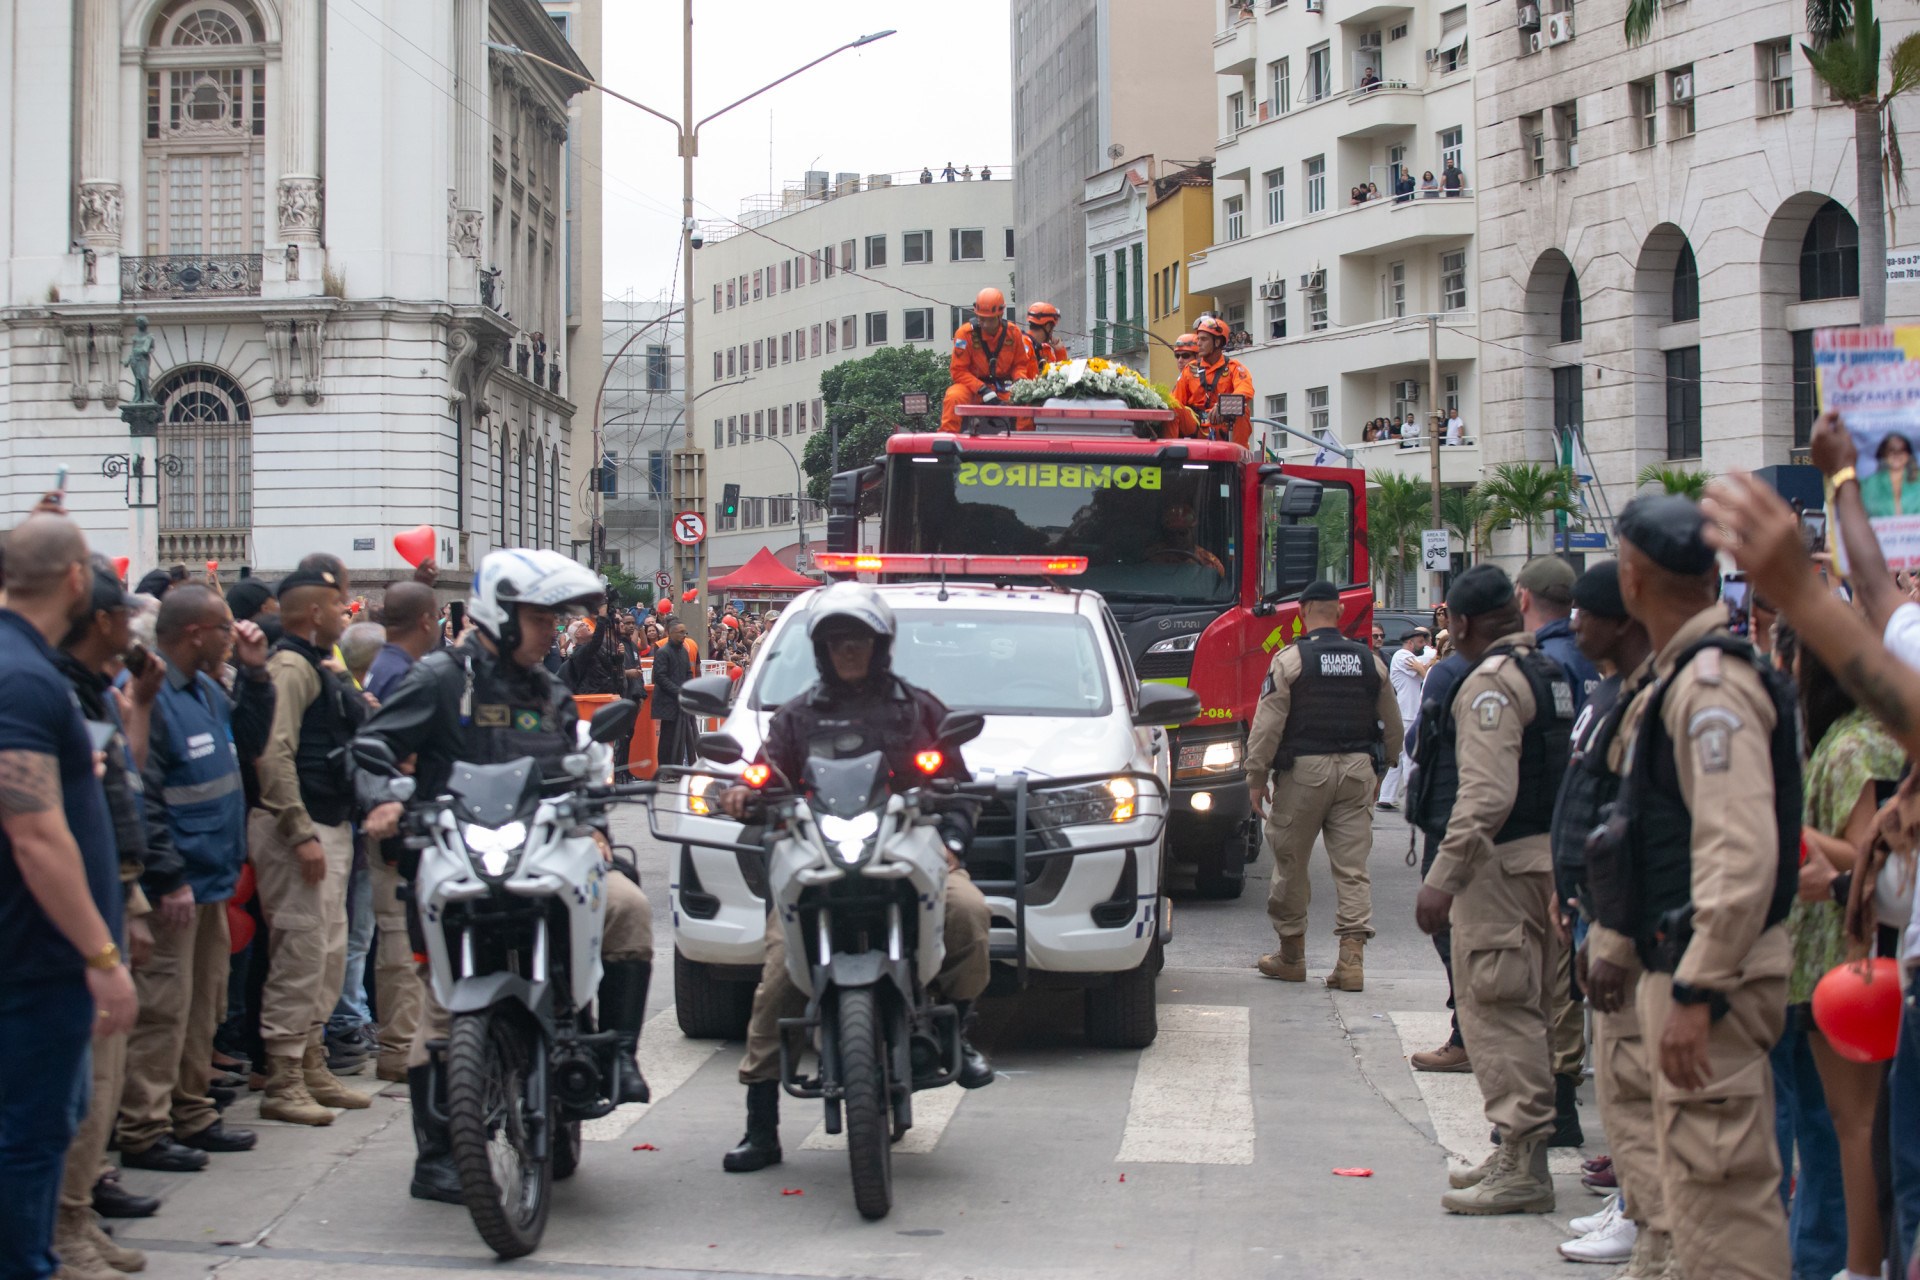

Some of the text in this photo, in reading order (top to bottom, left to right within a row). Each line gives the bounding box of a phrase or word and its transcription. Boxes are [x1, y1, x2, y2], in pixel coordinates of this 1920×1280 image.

[1320, 653, 1361, 665] GUARDA
[1321, 663, 1362, 673] MUNICIPAL
[1198, 707, 1233, 719] T-084
